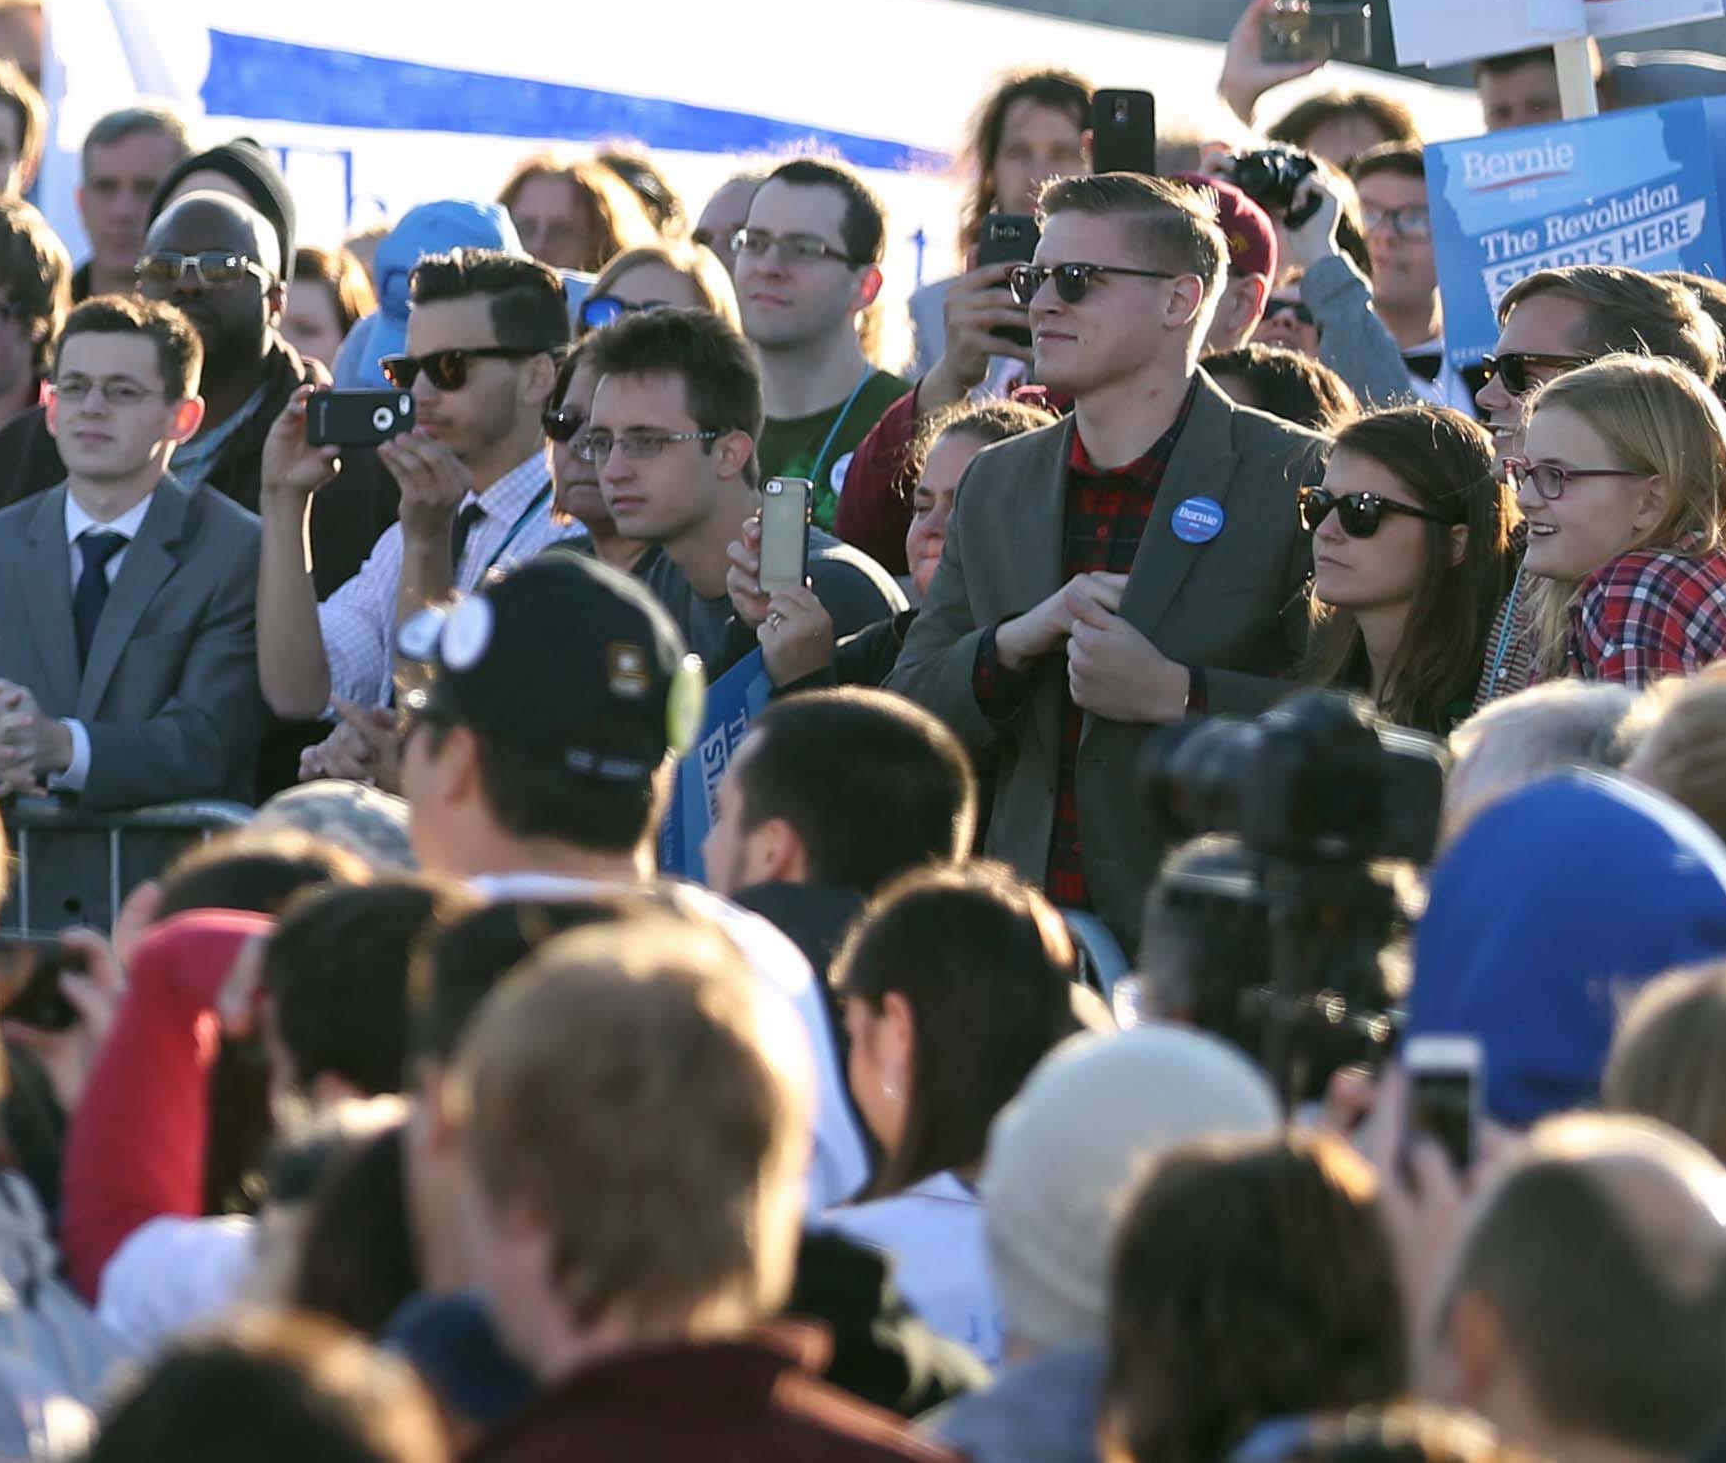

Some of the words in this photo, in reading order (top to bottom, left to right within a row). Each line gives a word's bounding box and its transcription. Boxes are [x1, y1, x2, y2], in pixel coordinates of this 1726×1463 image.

[1461, 140, 1575, 182] Bernie
[1480, 228, 1539, 261] The
[1544, 184, 1680, 247] Revolution
[1622, 213, 1691, 261] HERE
